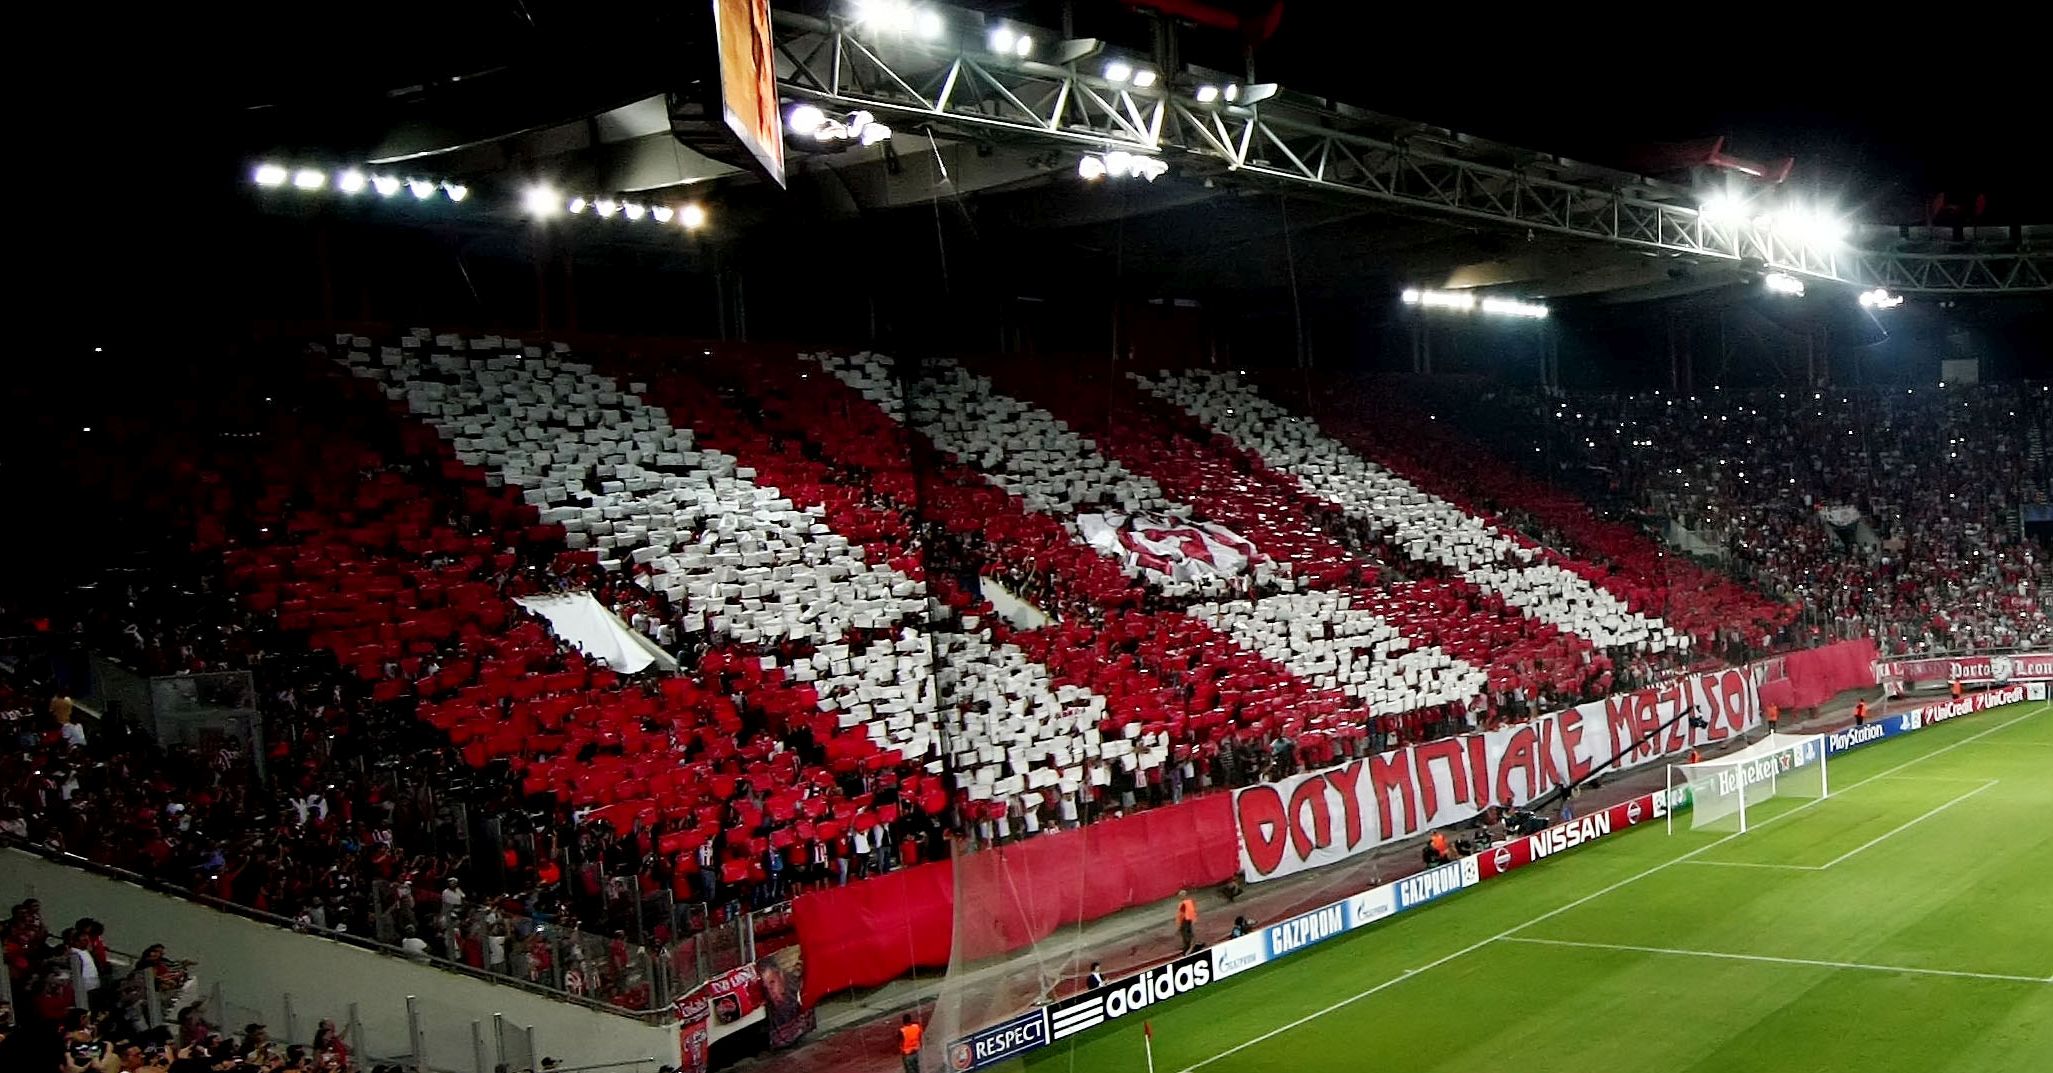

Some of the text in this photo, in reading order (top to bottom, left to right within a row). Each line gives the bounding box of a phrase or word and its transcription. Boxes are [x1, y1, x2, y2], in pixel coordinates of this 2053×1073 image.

[1950, 662, 1990, 680] Porto
[1934, 698, 1973, 722] UniCredit
[1985, 686, 2024, 709] UniCredit
[1829, 724, 1884, 752] PlayStation
[1529, 810, 1611, 862] NISSAN
[1400, 863, 1461, 908] GAZPROM
[1271, 904, 1343, 955] GAZPROM
[1105, 958, 1210, 1018] adidas
[975, 1020, 1043, 1060] RESPECT
